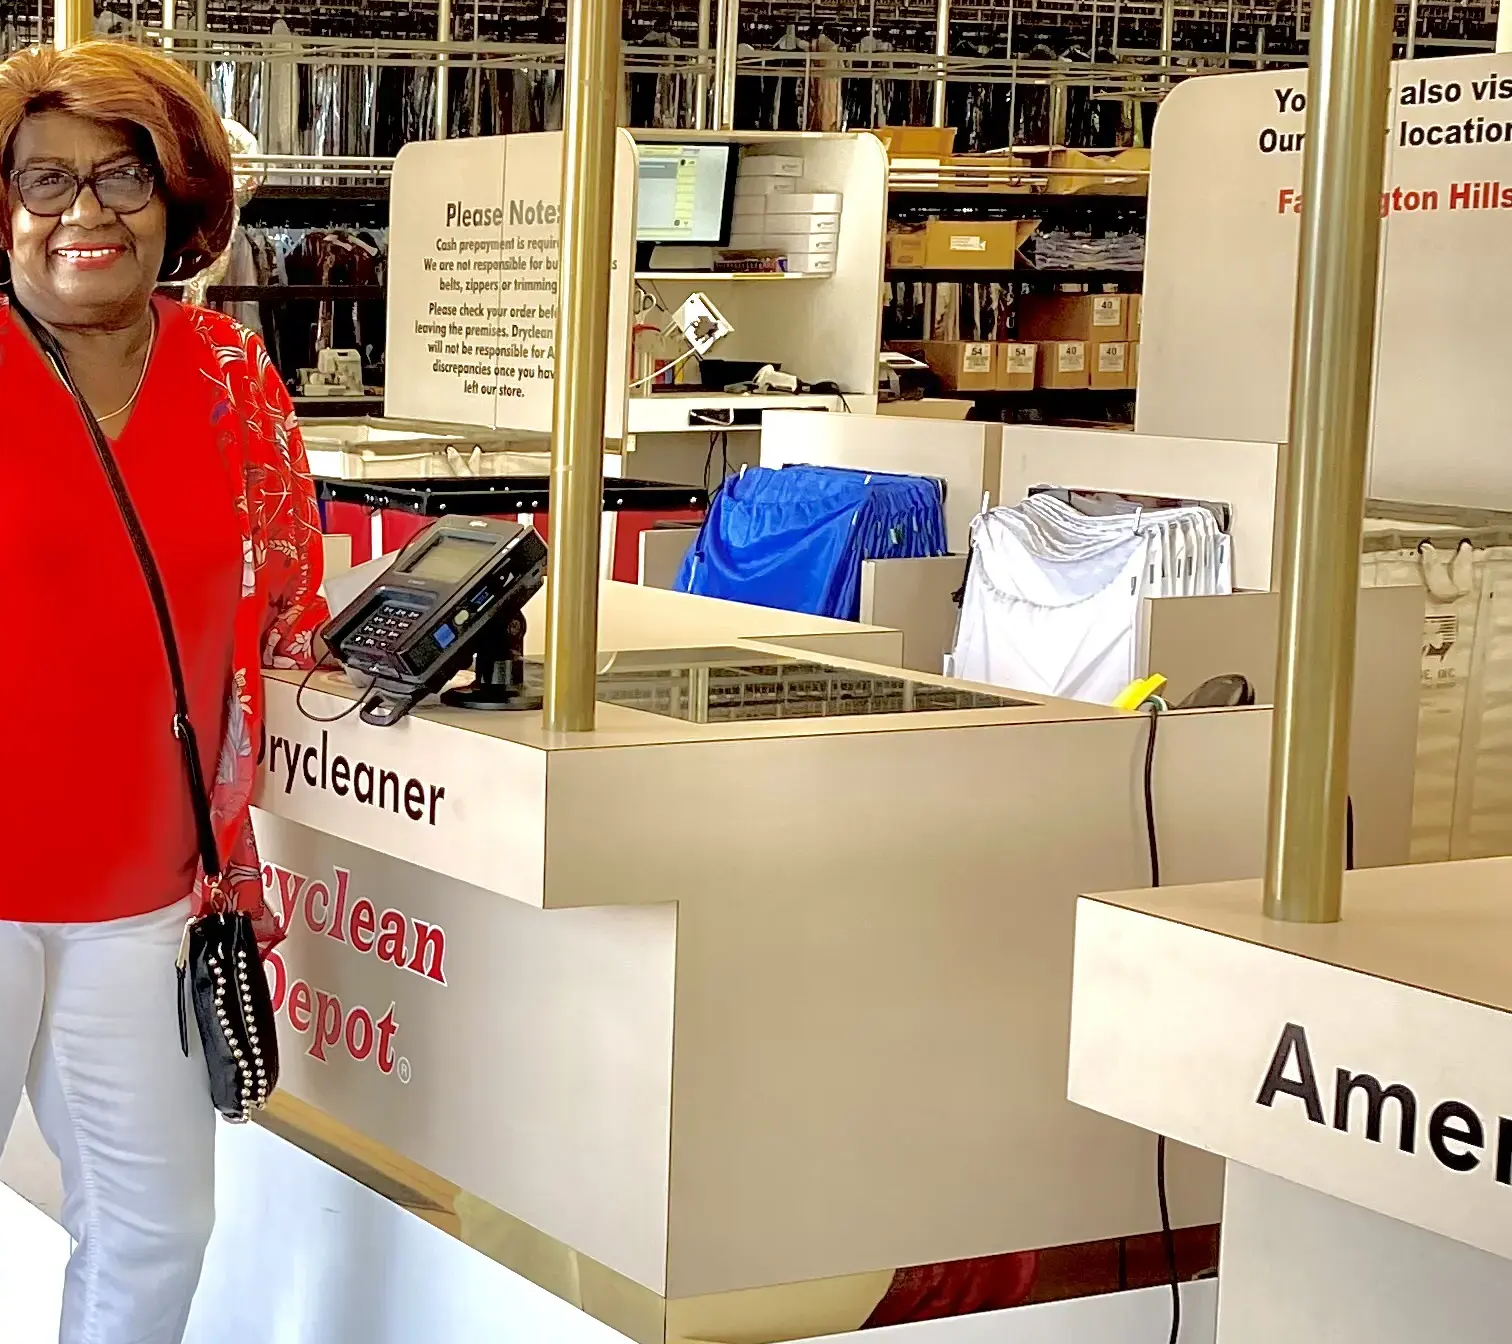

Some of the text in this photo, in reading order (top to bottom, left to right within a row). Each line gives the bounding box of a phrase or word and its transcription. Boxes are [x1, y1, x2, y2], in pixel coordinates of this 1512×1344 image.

[1274, 87, 1306, 113] Yo
[1399, 78, 1461, 105] also
[1259, 128, 1307, 153] Our
[1278, 186, 1439, 218] Fagton
[446, 201, 503, 227] Please
[436, 235, 559, 254] Cash prepayment is requir
[424, 258, 436, 271] We
[439, 261, 454, 271] are
[457, 259, 470, 270] not
[473, 256, 526, 274] responsible
[529, 256, 543, 270] for
[439, 277, 463, 293] belts,
[465, 278, 498, 294] zippers
[502, 281, 512, 290] or
[428, 302, 456, 316] Please
[459, 303, 484, 317] check
[487, 307, 507, 320] your
[510, 304, 536, 318] order
[415, 320, 553, 341] leaving the premises. Dryclean
[428, 340, 442, 353] will
[445, 343, 459, 354] not
[462, 341, 473, 355] be
[475, 343, 528, 359] responsible
[531, 344, 545, 358] for
[433, 359, 555, 381] discrepancies once you hav
[464, 380, 525, 397] left our store.
[257, 729, 445, 826] rycleaner
[261, 863, 448, 988] yclean
